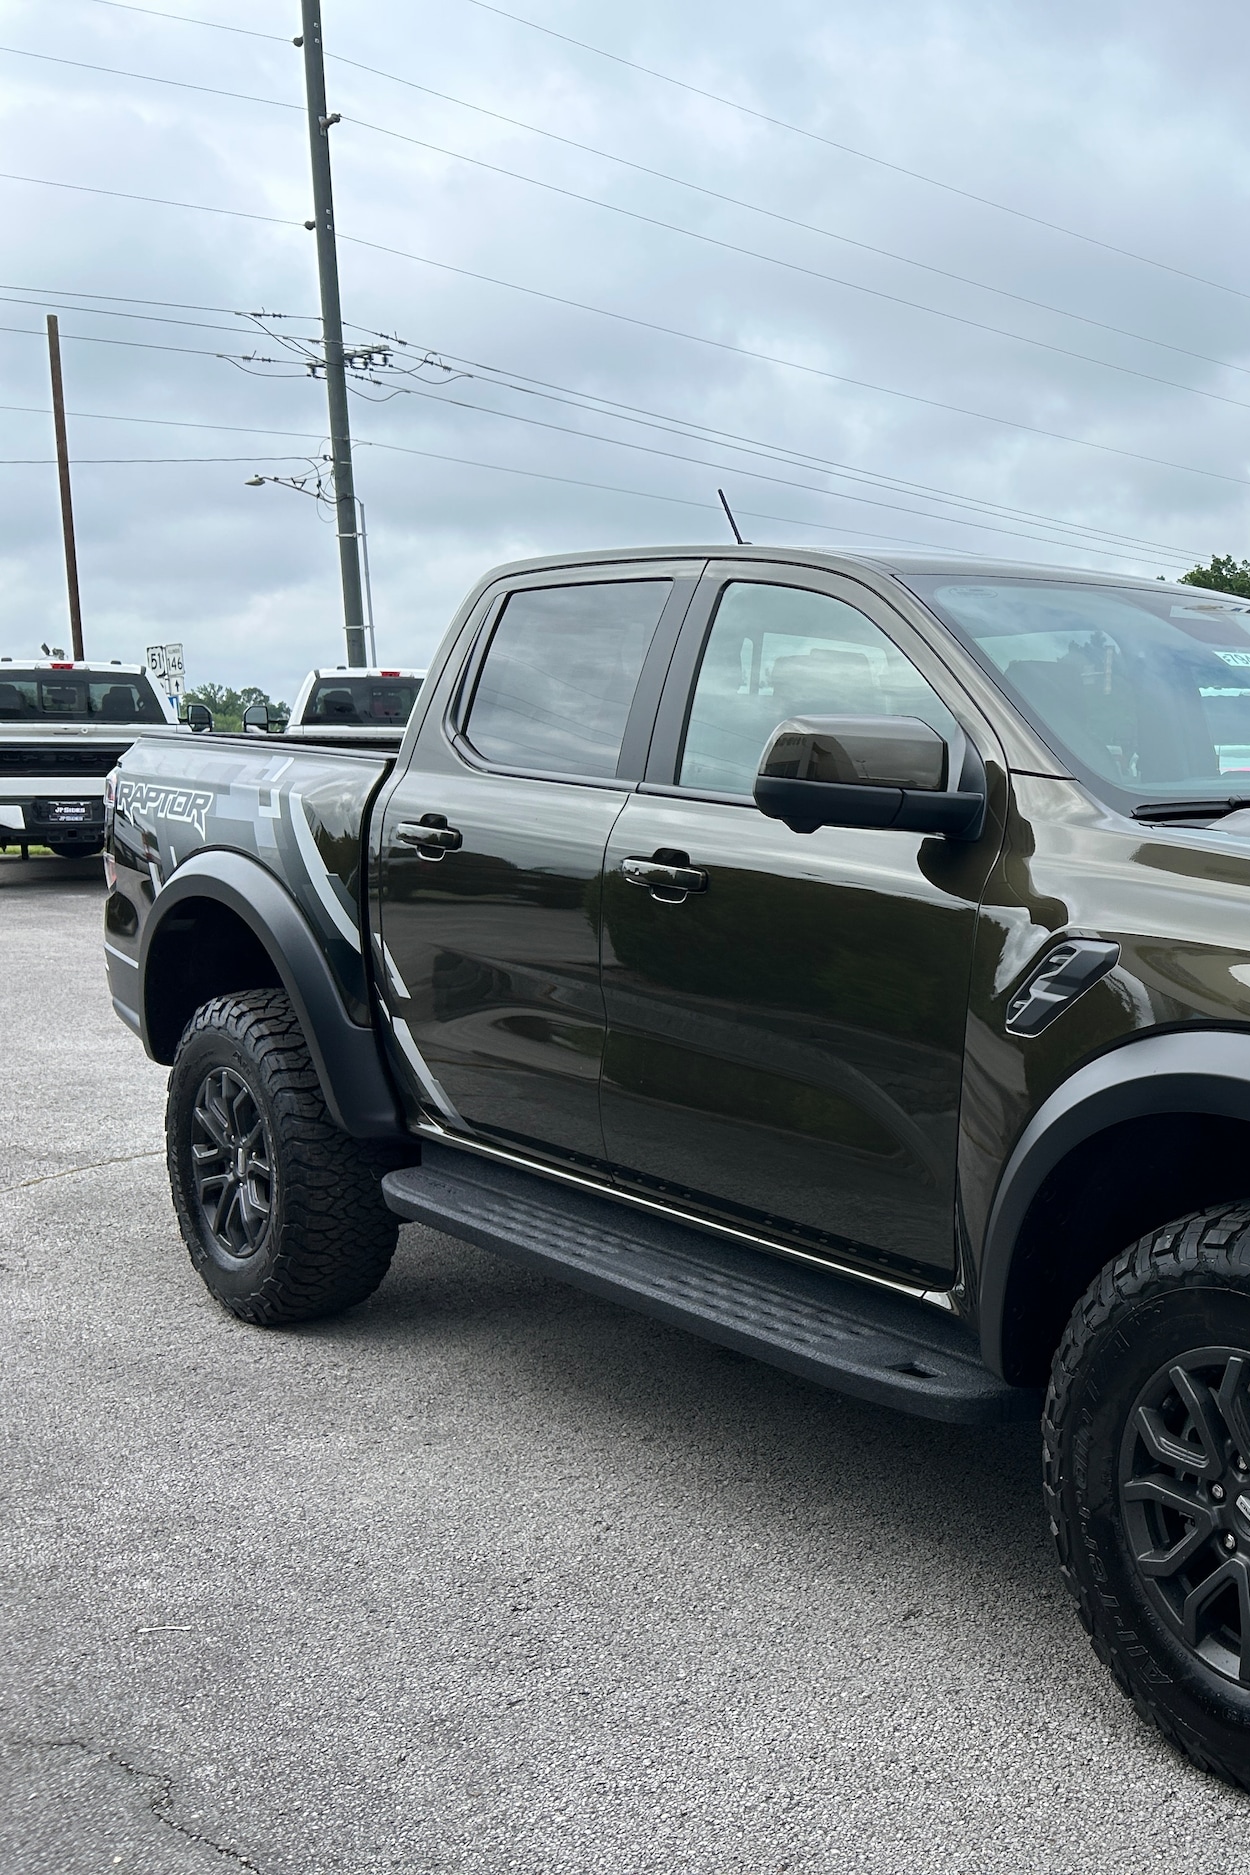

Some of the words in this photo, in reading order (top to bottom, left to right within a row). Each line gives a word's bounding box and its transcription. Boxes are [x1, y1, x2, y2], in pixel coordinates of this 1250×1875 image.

[151, 653, 162, 670] 51
[167, 657, 183, 670] 146
[117, 781, 214, 842] RAPTOR
